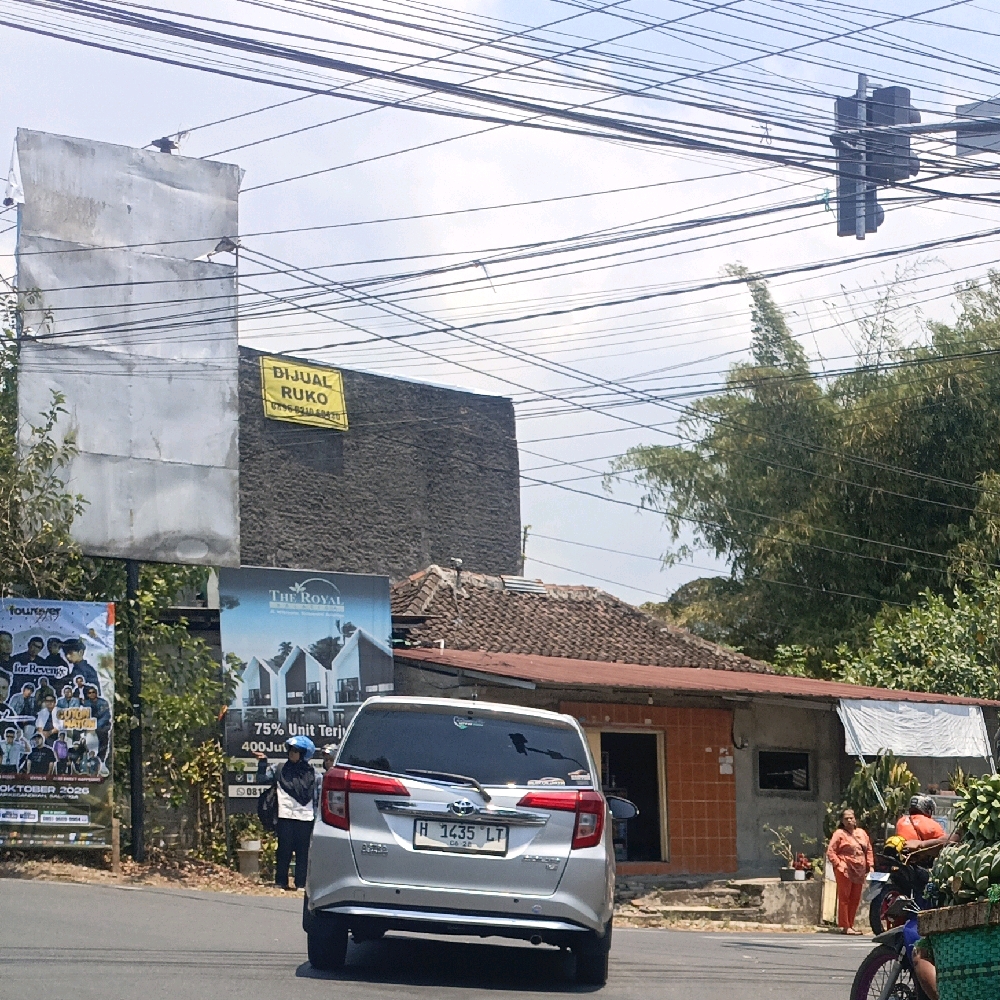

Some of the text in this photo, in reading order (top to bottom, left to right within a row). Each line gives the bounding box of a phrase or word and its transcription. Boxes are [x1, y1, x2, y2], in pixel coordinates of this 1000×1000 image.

[281, 386, 328, 405] RUKO
[300, 592, 344, 605] ROYAL
[14, 663, 67, 677] for Revenge
[254, 722, 284, 736] 75%
[288, 723, 315, 737] Unit
[0, 784, 56, 794] OKTOBER
[419, 822, 504, 843] H 1435 LT
